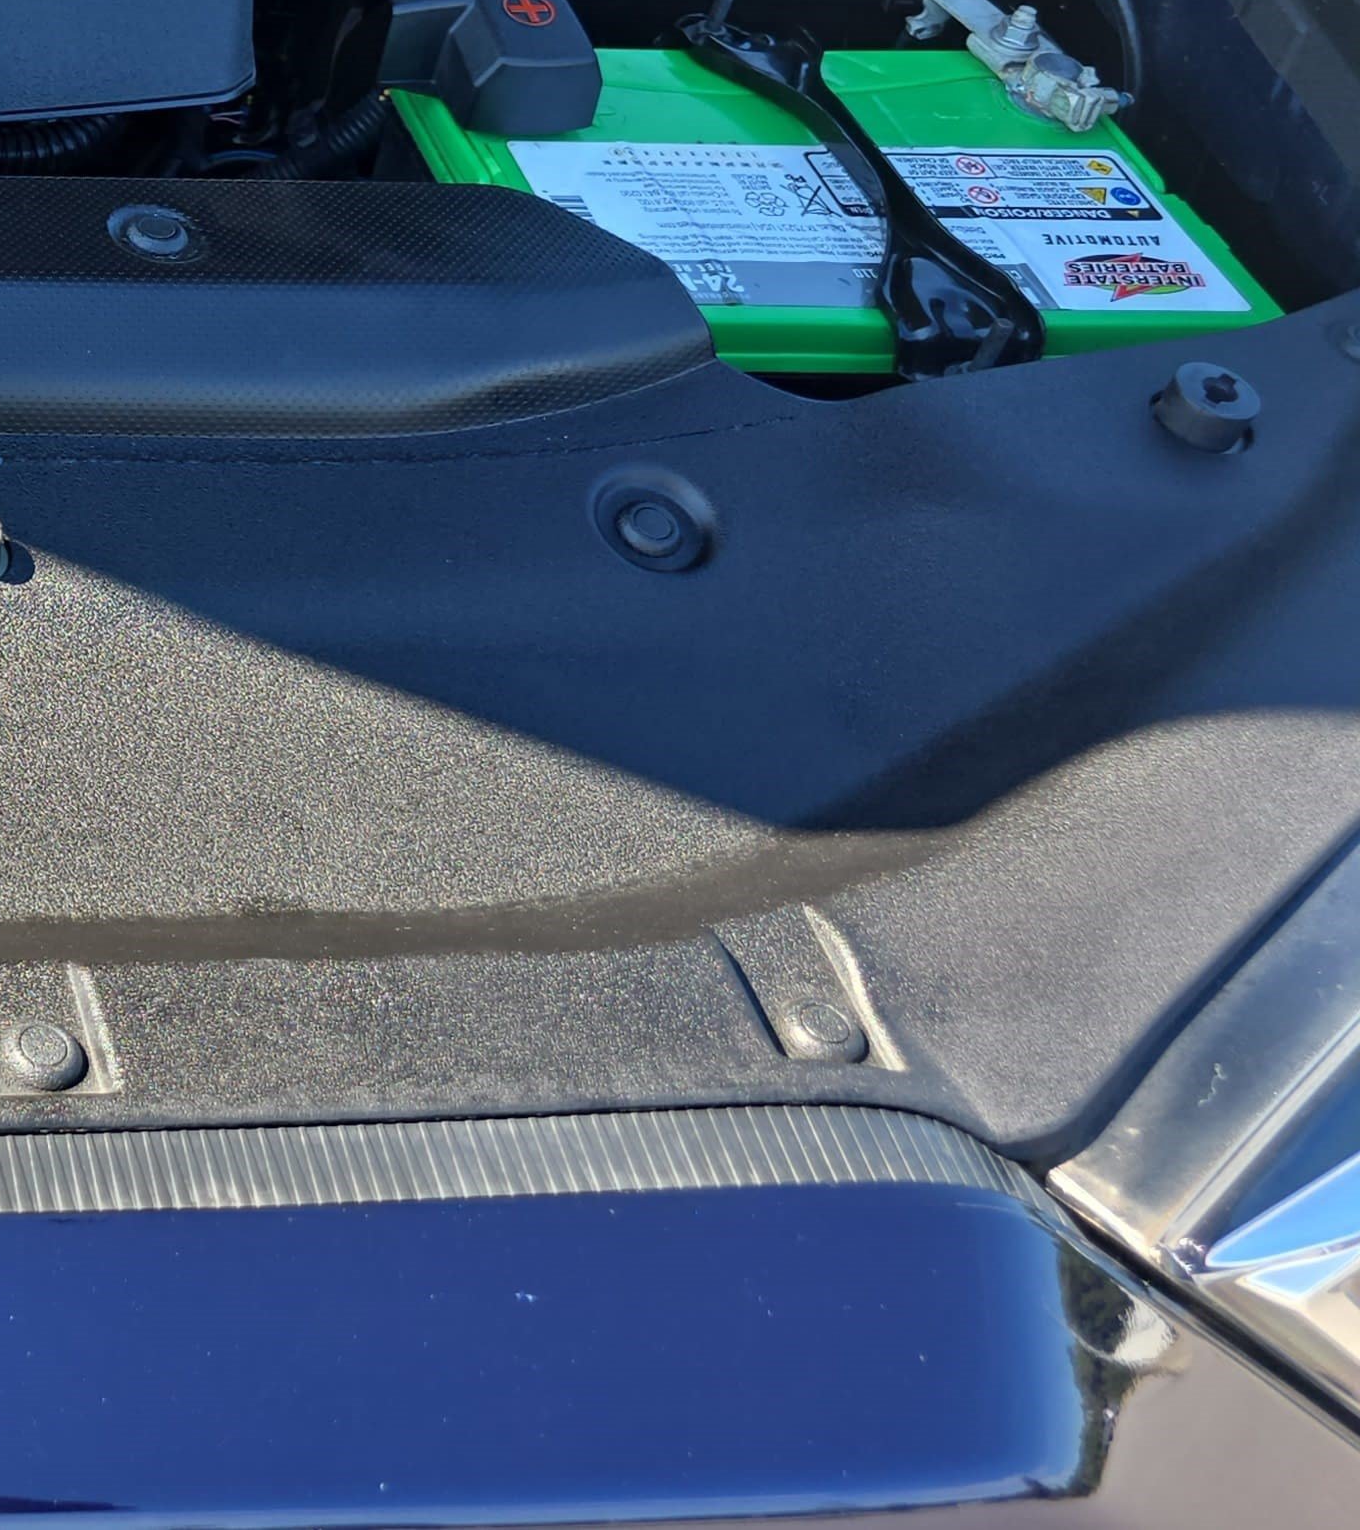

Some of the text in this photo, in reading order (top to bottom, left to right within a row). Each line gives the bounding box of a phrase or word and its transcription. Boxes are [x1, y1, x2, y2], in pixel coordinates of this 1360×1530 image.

[971, 207, 1112, 219] DANGER/POISON
[1041, 234, 1160, 246] AUTOMOTIVE
[1068, 262, 1186, 274] BATTERIES
[1068, 274, 1201, 287] INTERSTATE
